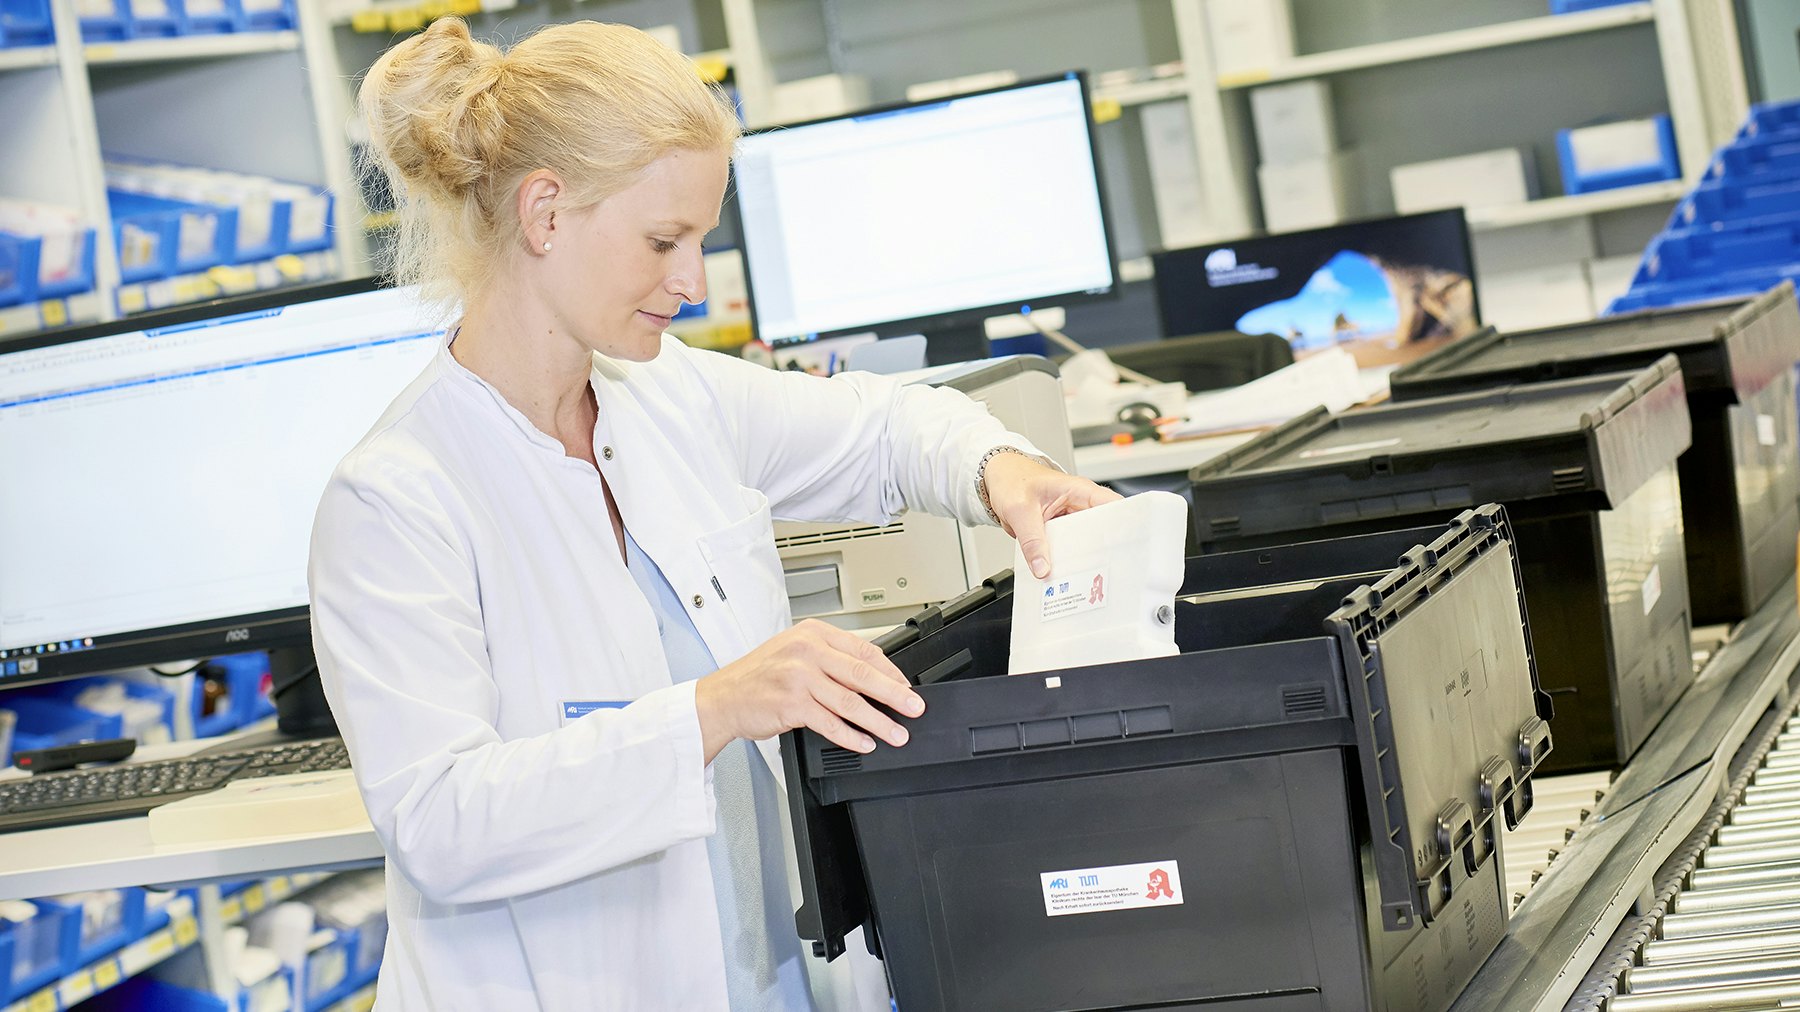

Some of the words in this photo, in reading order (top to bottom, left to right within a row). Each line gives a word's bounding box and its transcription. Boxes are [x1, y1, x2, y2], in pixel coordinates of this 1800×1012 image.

[863, 594, 883, 602] PUSH
[225, 629, 249, 643] AOC
[1049, 878, 1068, 889] MRI
